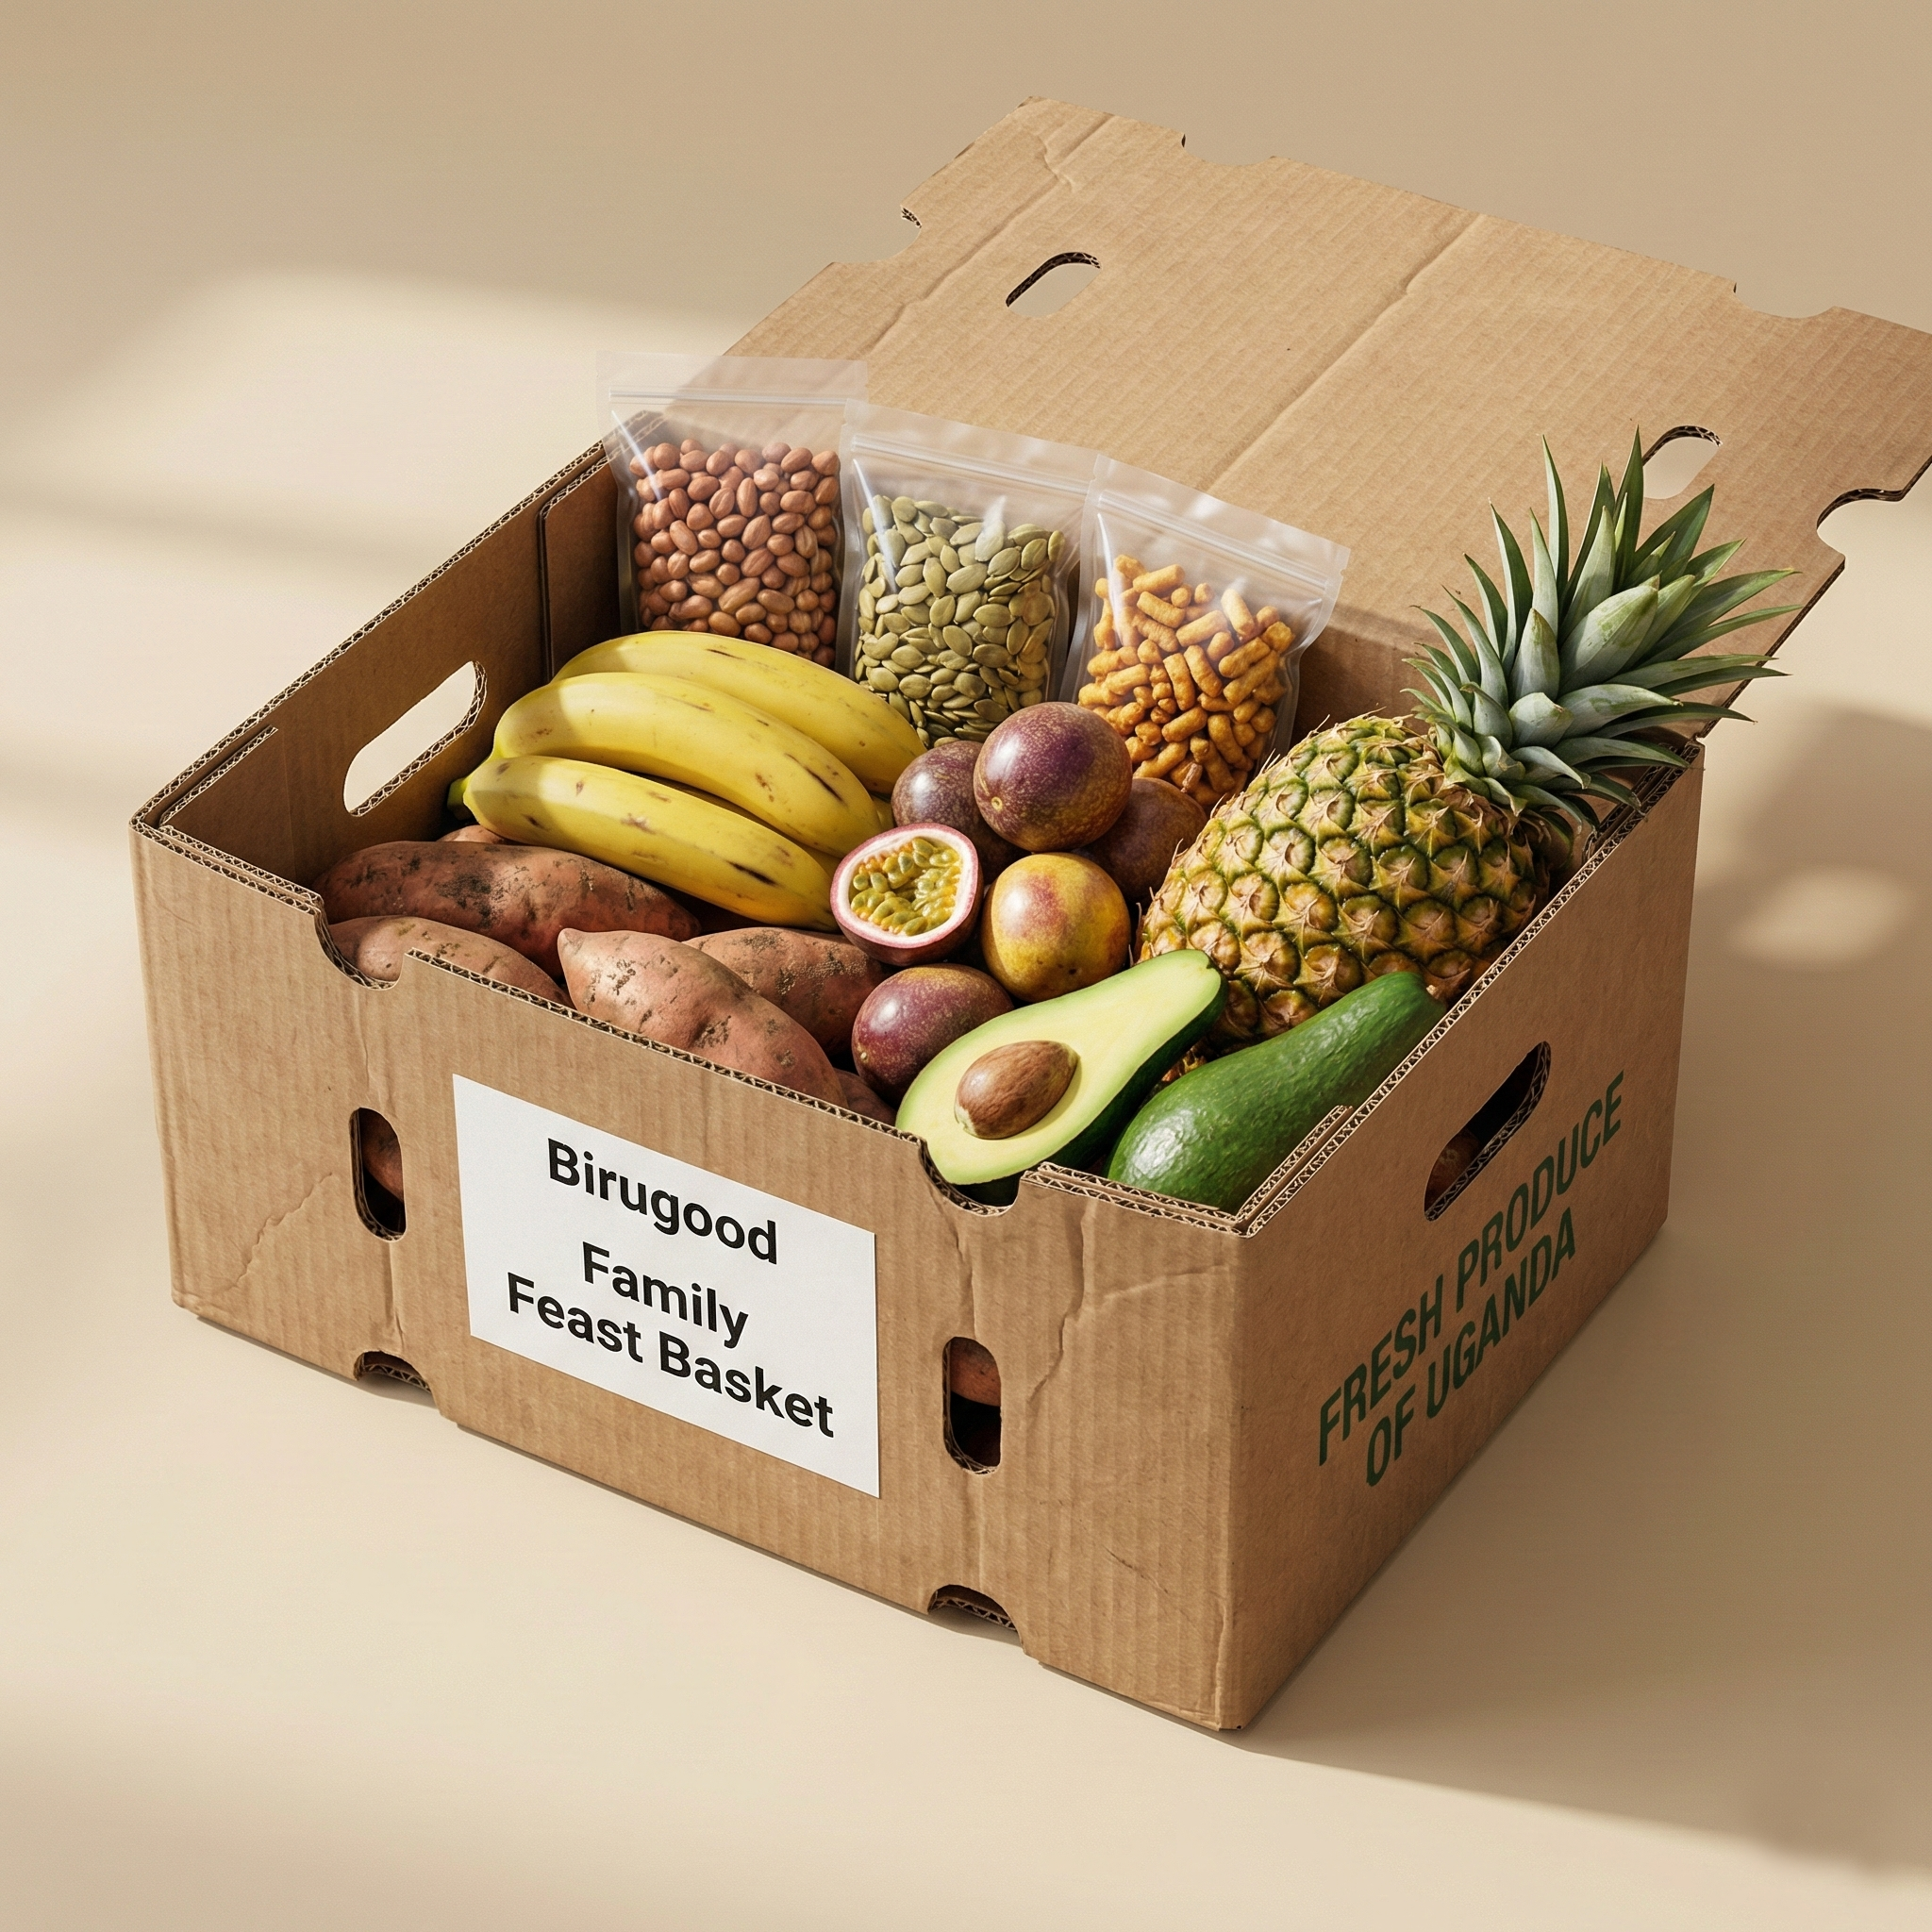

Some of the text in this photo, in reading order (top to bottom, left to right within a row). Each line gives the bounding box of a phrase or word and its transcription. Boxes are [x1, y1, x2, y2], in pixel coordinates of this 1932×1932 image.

[548, 1138, 777, 1265] Birugood
[1320, 1070, 1624, 1466] FRESH PRODUCE
[508, 1272, 834, 1439] Feast Basket
[583, 1241, 749, 1349] Family
[1366, 1208, 1575, 1487] OF UGANDA
